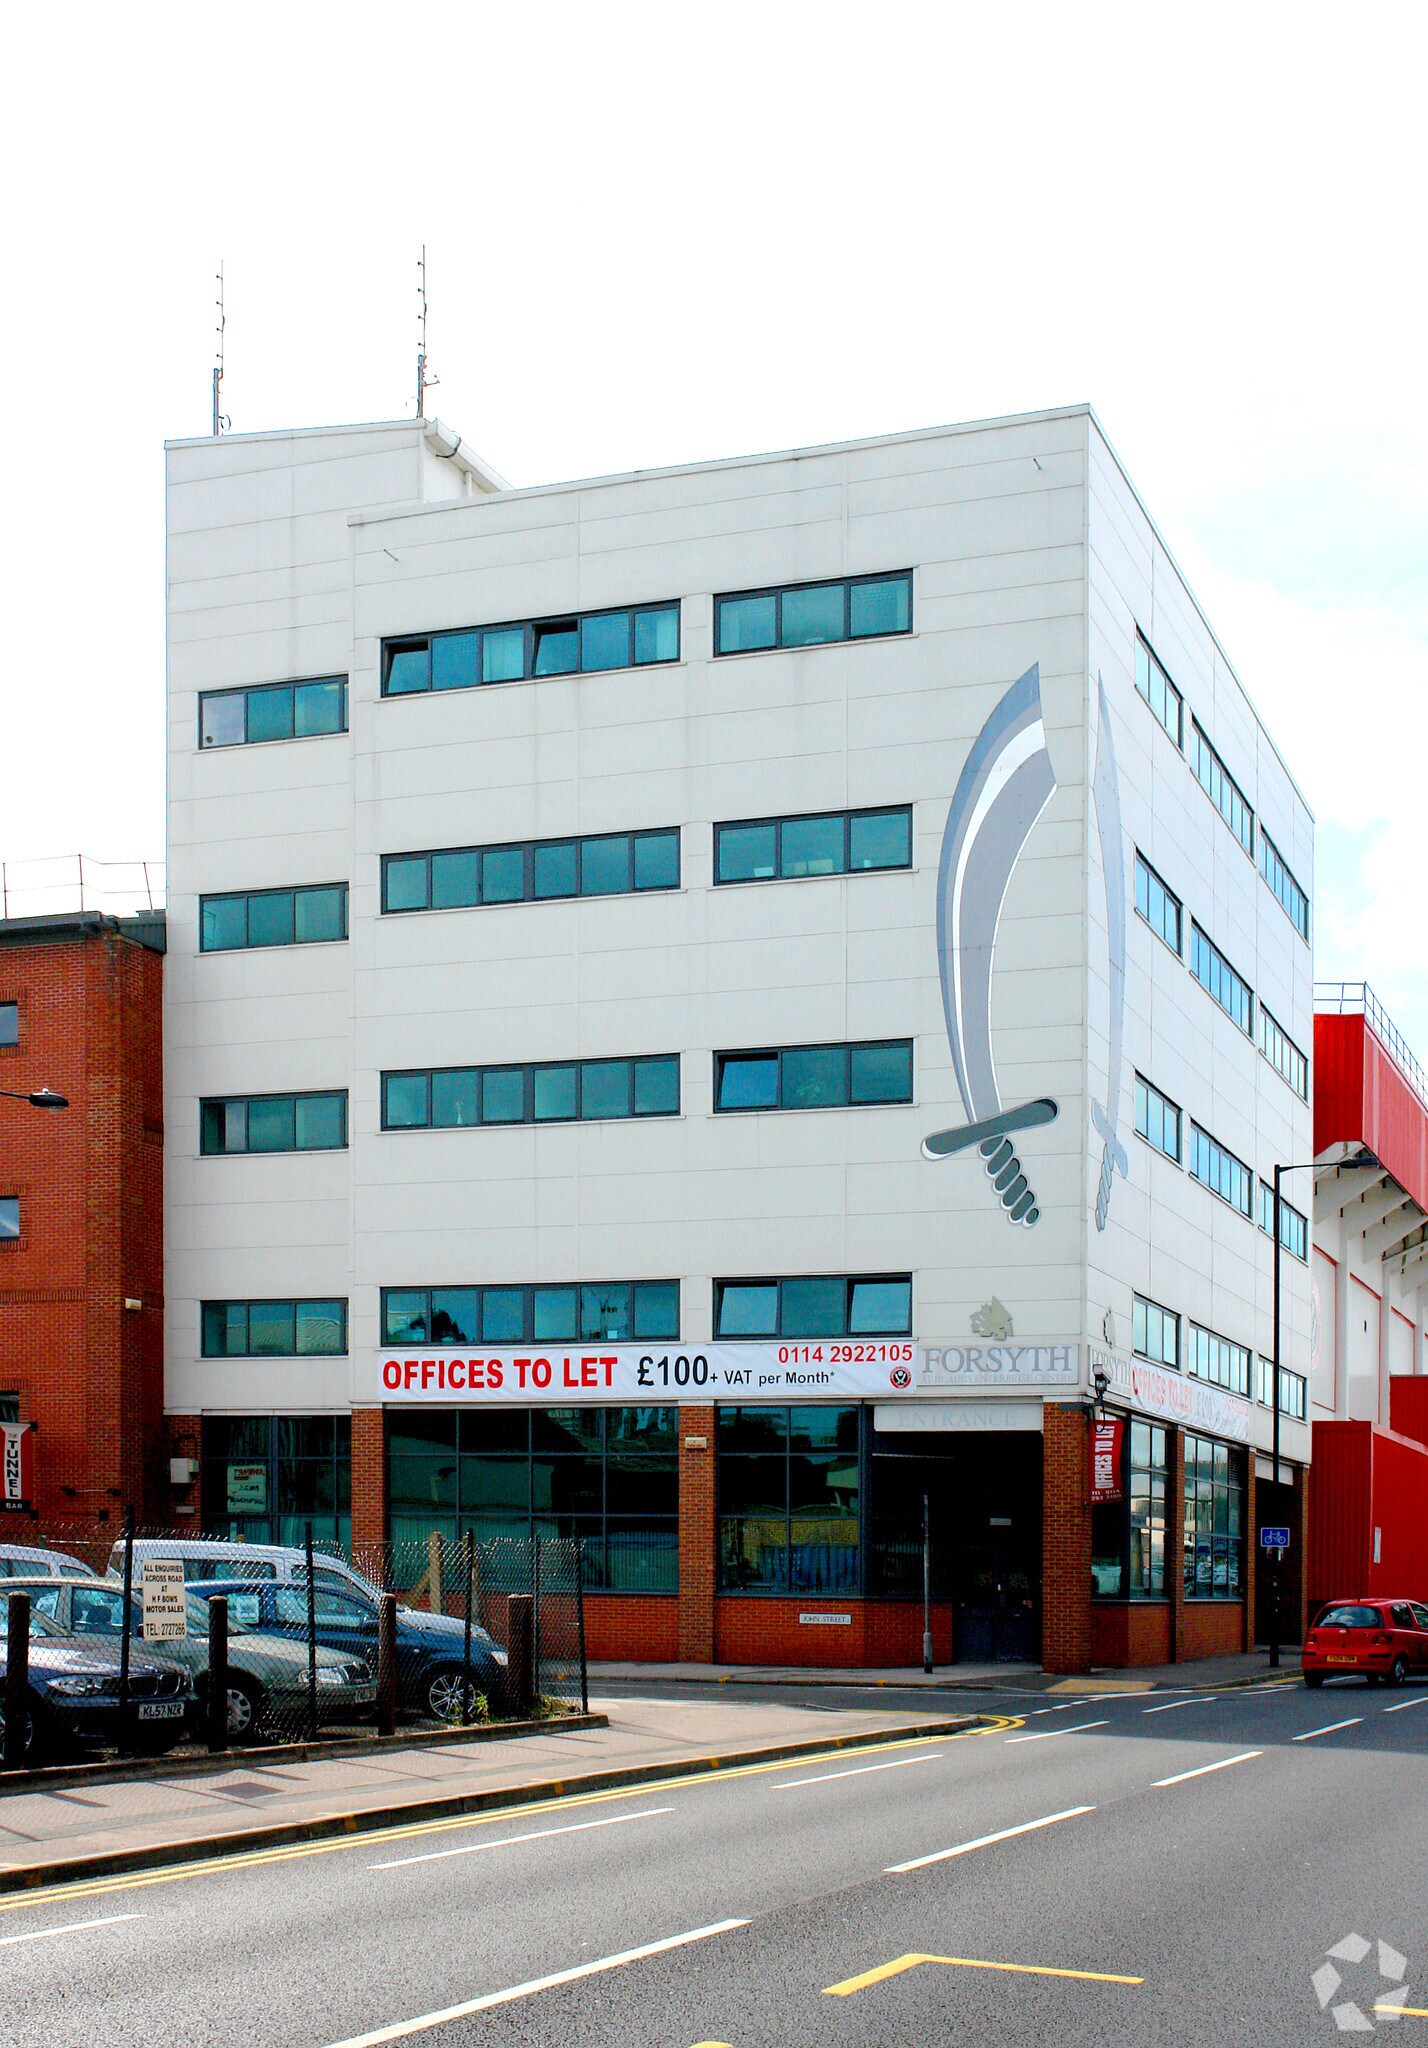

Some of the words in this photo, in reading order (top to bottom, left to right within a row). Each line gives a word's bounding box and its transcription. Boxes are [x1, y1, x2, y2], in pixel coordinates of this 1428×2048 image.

[778, 1346, 823, 1363] 0114
[830, 1345, 913, 1362] 2922105
[922, 1346, 1072, 1373] FORSYTH
[383, 1359, 503, 1389] OFFICES
[514, 1358, 552, 1388] TO
[563, 1357, 617, 1387] LET
[724, 1370, 752, 1384] VAT
[758, 1374, 781, 1387] per
[900, 1408, 1017, 1427] ENTRANCE
[1096, 1424, 1115, 1438] LET
[1095, 1440, 1113, 1452] TO
[7, 1440, 19, 1497] TUNNEL
[1095, 1455, 1114, 1488] OFFICES
[155, 1564, 183, 1572] ENQUIRIES
[146, 1605, 166, 1613] MOTOR
[167, 1605, 184, 1613] SALES
